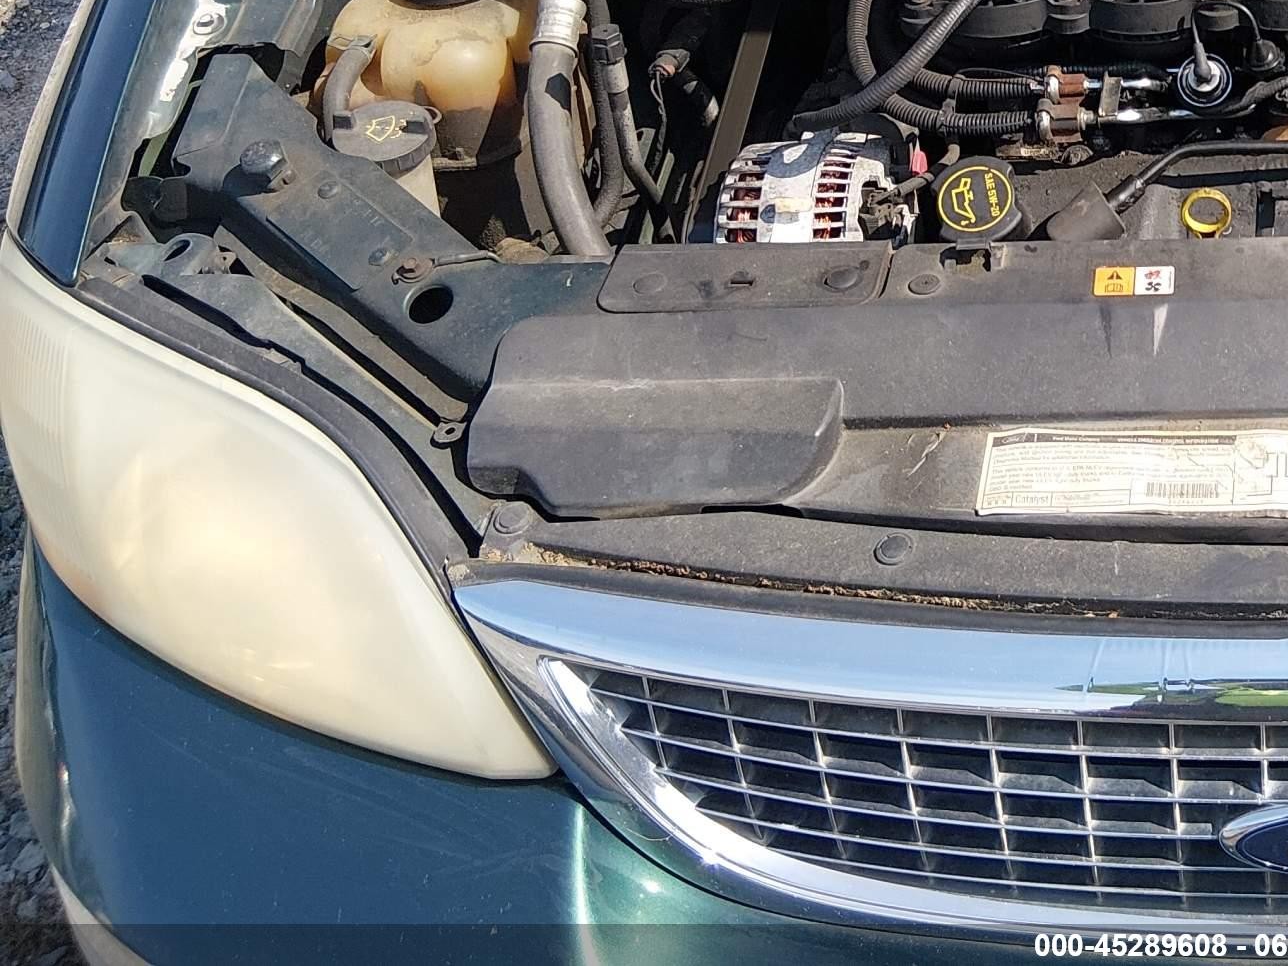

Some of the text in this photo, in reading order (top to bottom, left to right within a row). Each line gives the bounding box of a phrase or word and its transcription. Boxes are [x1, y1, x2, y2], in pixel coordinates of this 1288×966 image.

[984, 172, 1001, 217] SAE 5W-20
[1015, 494, 1049, 504] Catalyst
